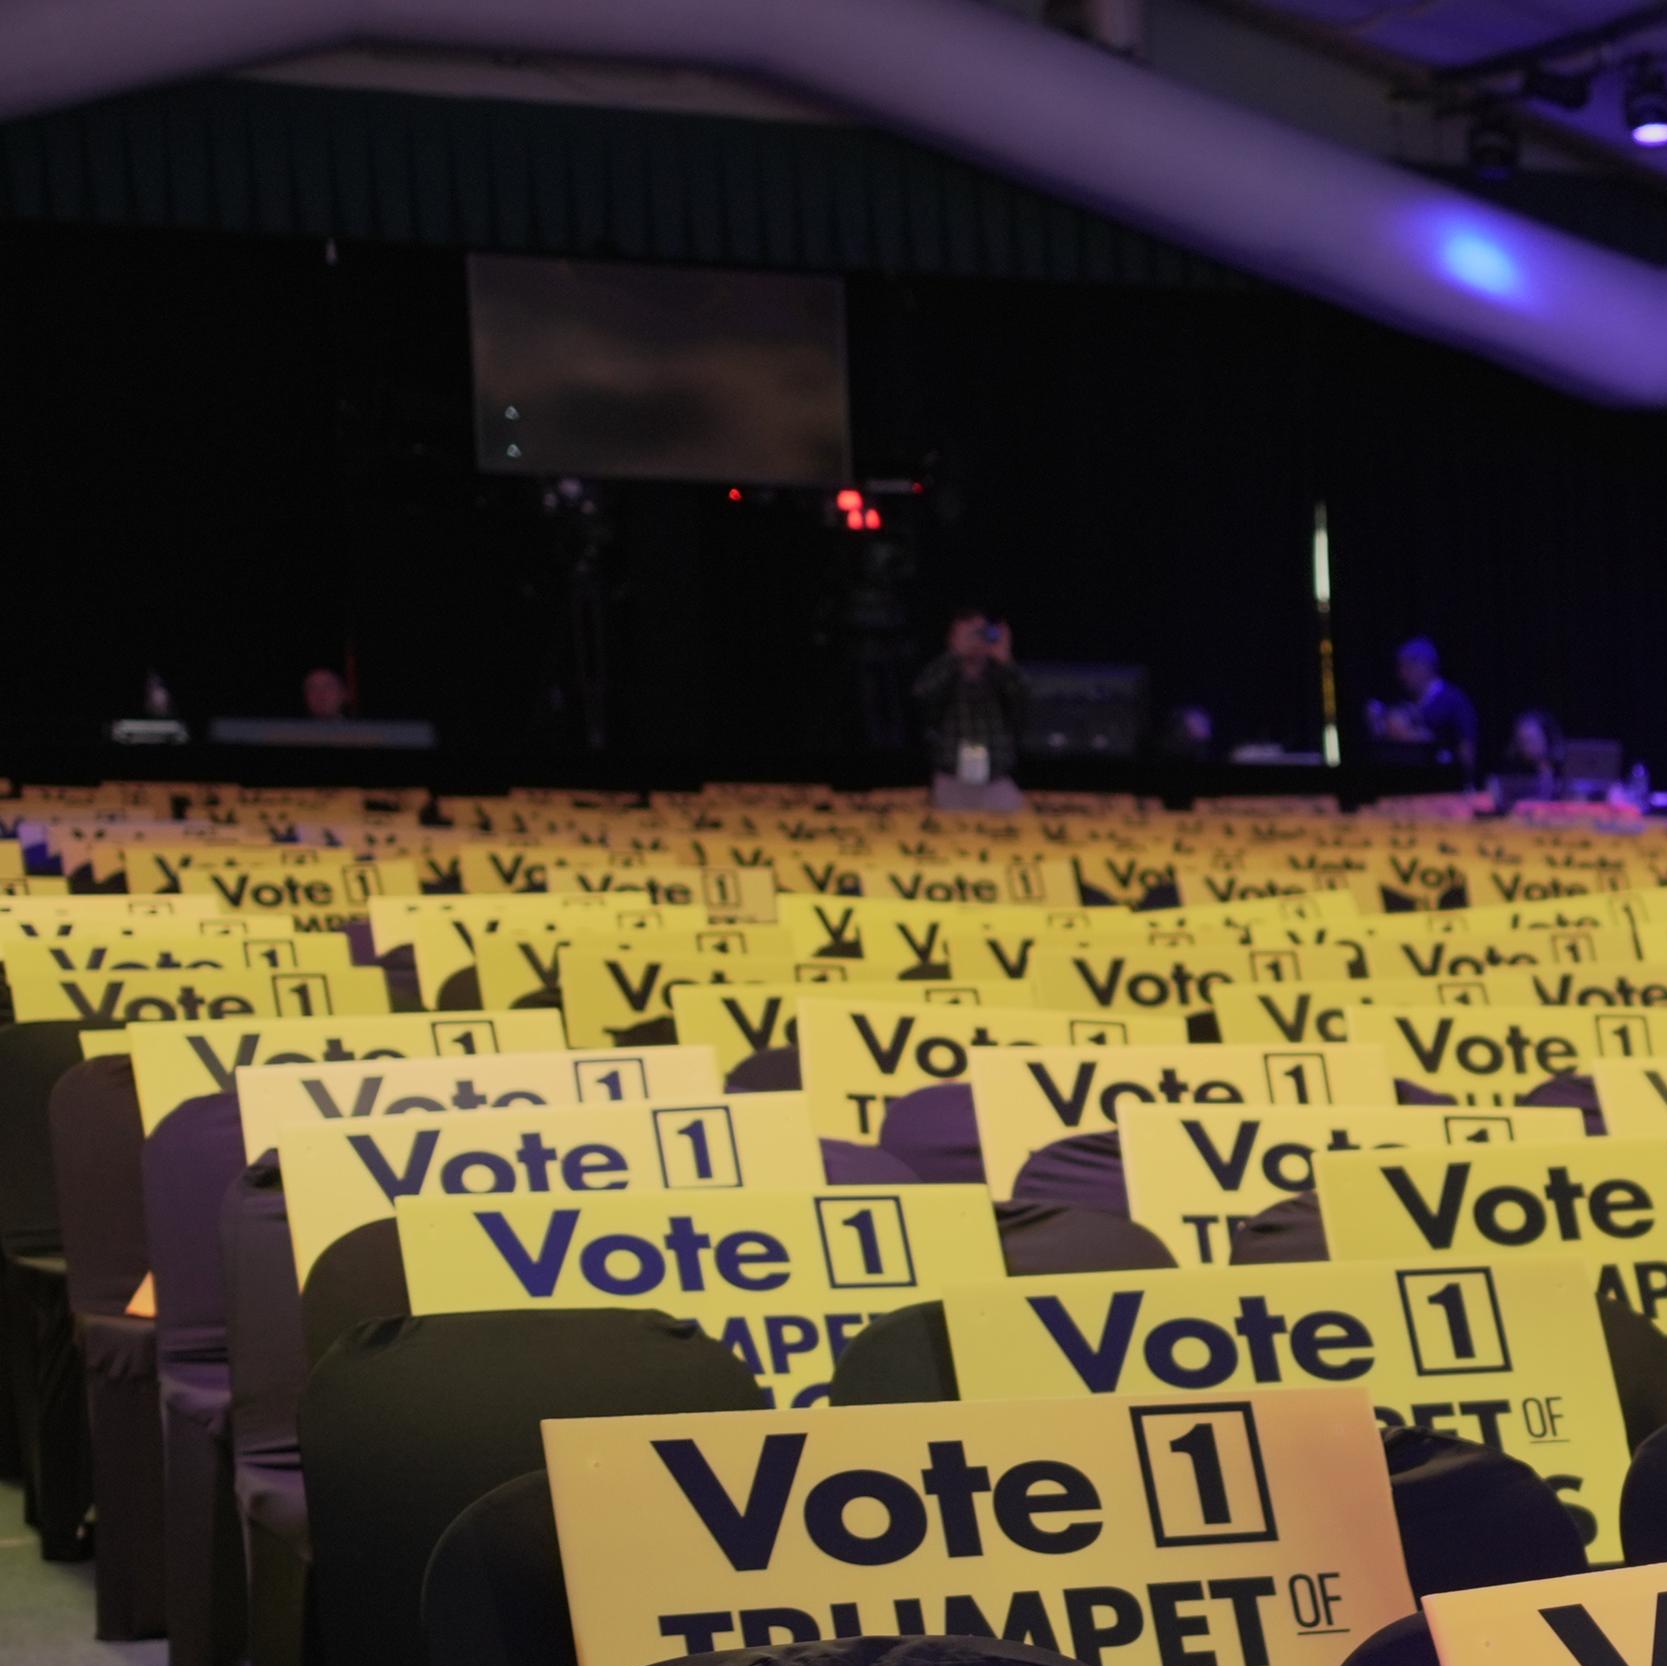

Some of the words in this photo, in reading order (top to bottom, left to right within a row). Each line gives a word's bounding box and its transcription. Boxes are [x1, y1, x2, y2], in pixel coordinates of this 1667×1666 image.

[212, 875, 333, 907] Vote
[1395, 1017, 1579, 1075] Vote
[346, 1129, 629, 1208] Vote
[1379, 1162, 1655, 1250] Vote
[473, 1208, 791, 1298] Vote
[1027, 1290, 1375, 1393] Vote
[1522, 1397, 1563, 1438] OF
[651, 1433, 1105, 1571] Vote
[1288, 1573, 1342, 1628] OF
